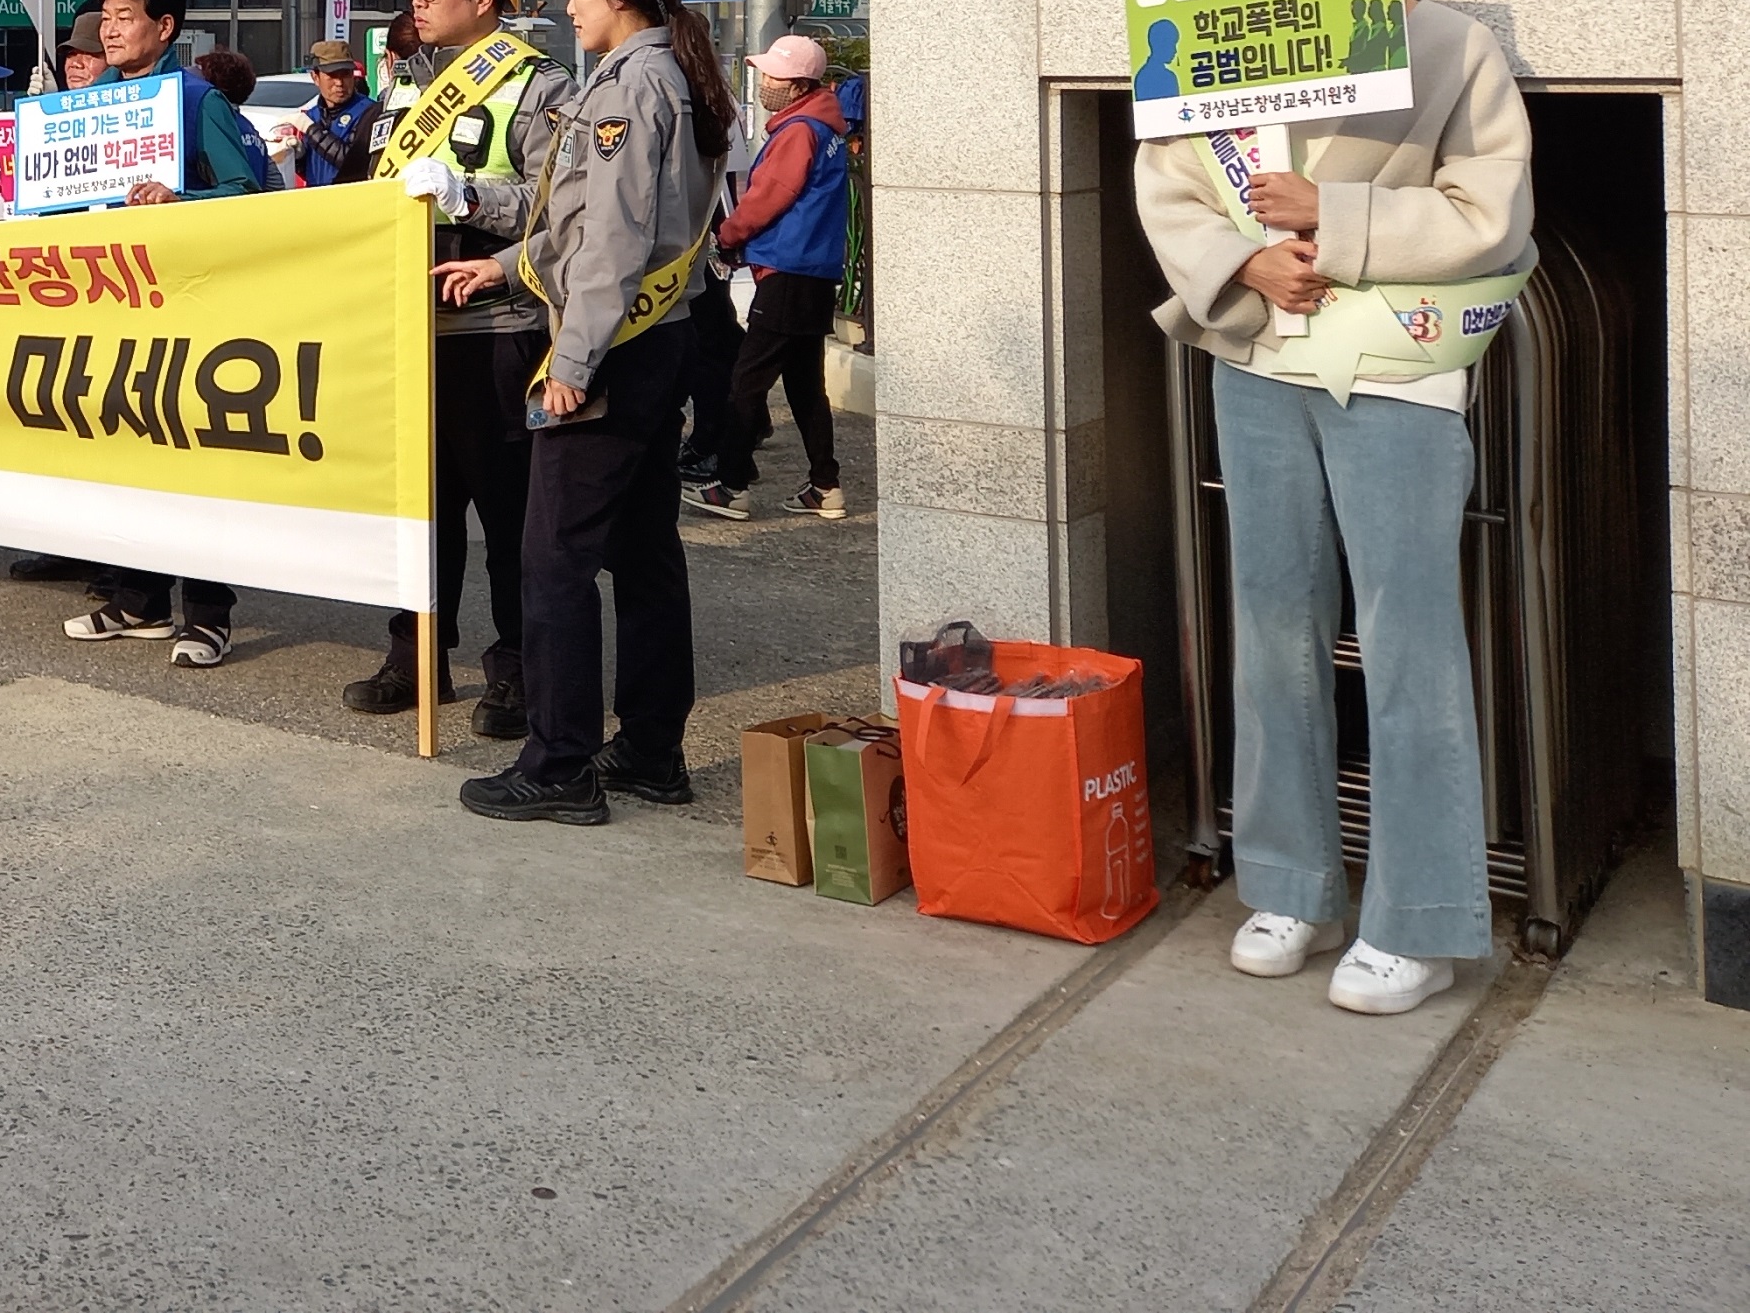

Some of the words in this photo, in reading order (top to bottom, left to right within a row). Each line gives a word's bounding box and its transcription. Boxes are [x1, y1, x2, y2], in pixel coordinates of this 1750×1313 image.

[463, 39, 518, 86] 함께
[1190, 36, 1333, 88] 공범입니다!
[59, 85, 141, 112] 학교폭력예방
[399, 81, 467, 160] 만들어
[1198, 84, 1359, 119] 경상남도창녕교육지원청
[44, 117, 86, 145] 웃으며
[91, 113, 119, 136] 가는
[125, 107, 154, 130] 학교
[25, 149, 59, 182] 내가
[64, 144, 98, 177] 없앤
[104, 132, 174, 169] 학교폭력
[6, 333, 325, 462] 마세요!
[1084, 760, 1137, 802] PLASTIC
